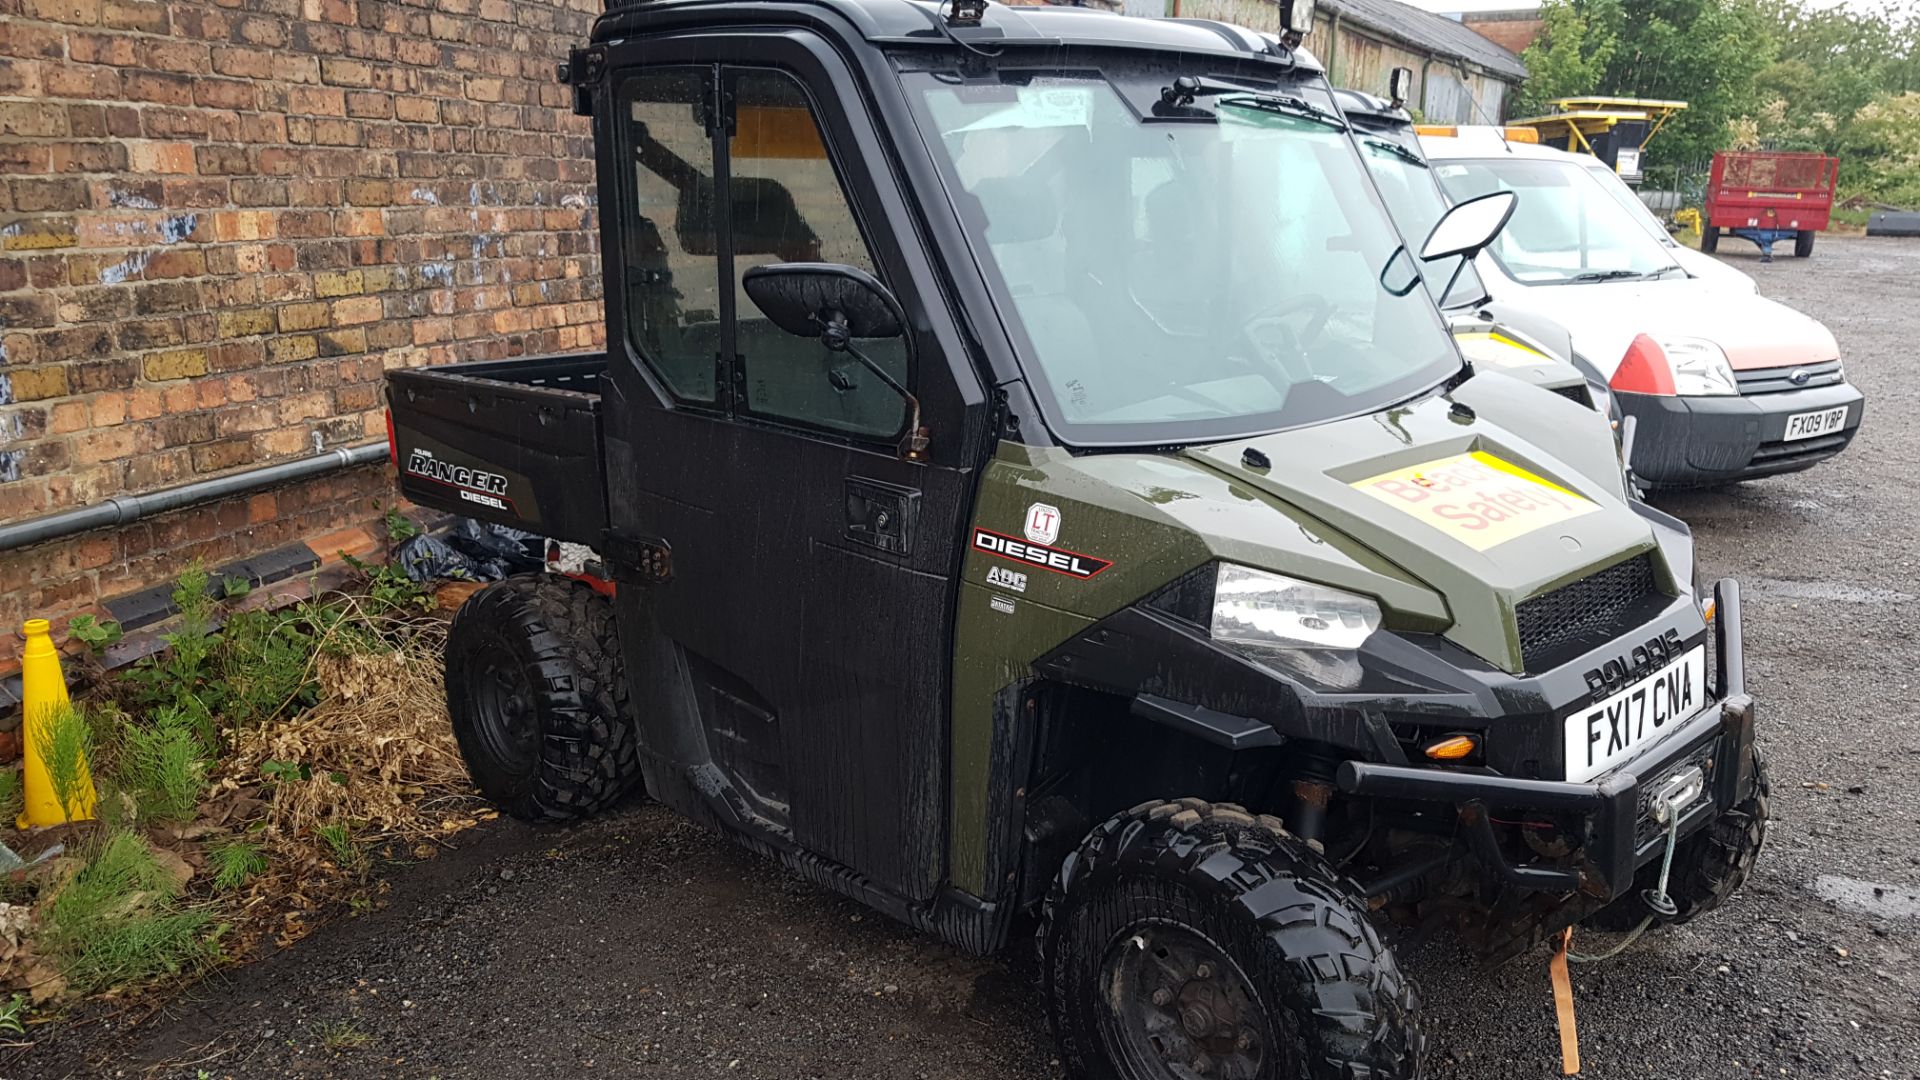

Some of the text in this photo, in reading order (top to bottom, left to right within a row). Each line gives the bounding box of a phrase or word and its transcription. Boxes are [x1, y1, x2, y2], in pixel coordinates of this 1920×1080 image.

[1790, 409, 1844, 436] FX09 YBP
[408, 454, 508, 496] RANGER
[1371, 460, 1510, 503] Beach
[460, 490, 508, 511] DIESEL
[1032, 511, 1055, 531] LT
[1432, 485, 1573, 531] Safety
[976, 532, 1090, 575] DIESEL
[1583, 627, 1684, 701] POLARIS
[1587, 661, 1692, 767] FX17 CNA
